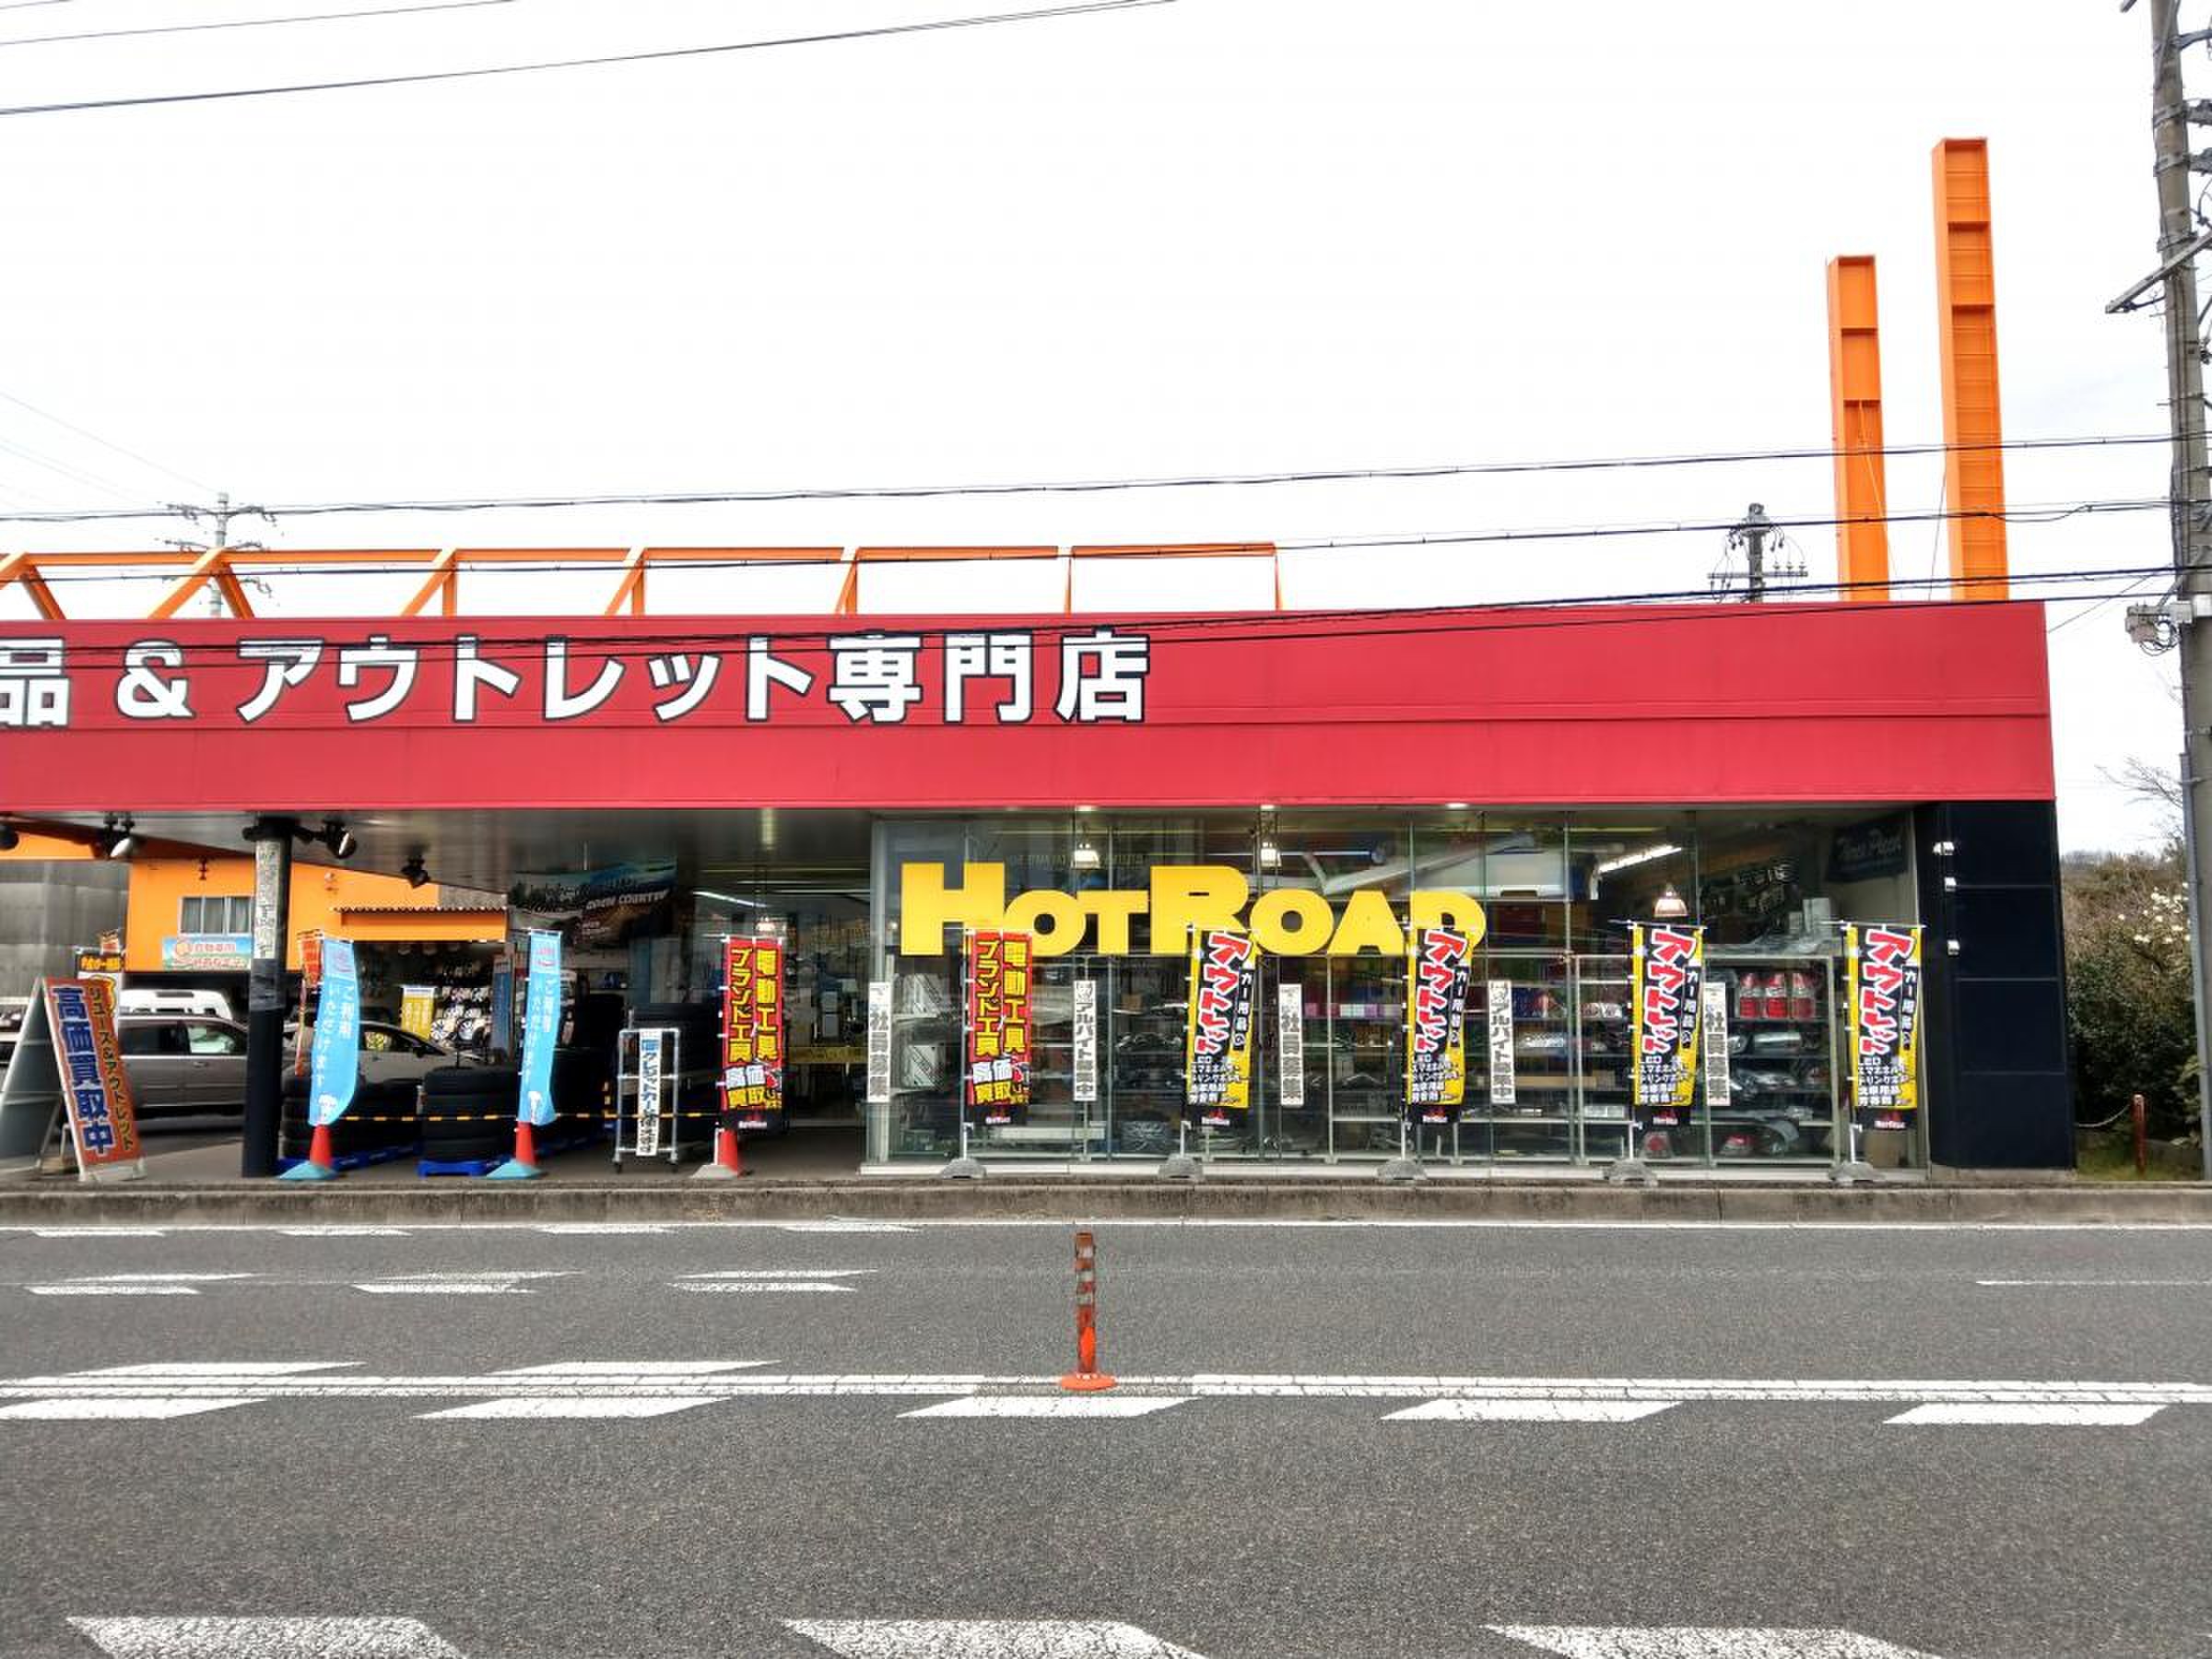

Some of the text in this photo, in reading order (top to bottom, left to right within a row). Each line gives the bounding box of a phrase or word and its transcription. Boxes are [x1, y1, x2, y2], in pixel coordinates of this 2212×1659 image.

[0, 627, 1151, 726] 品 & アウトレット専門店
